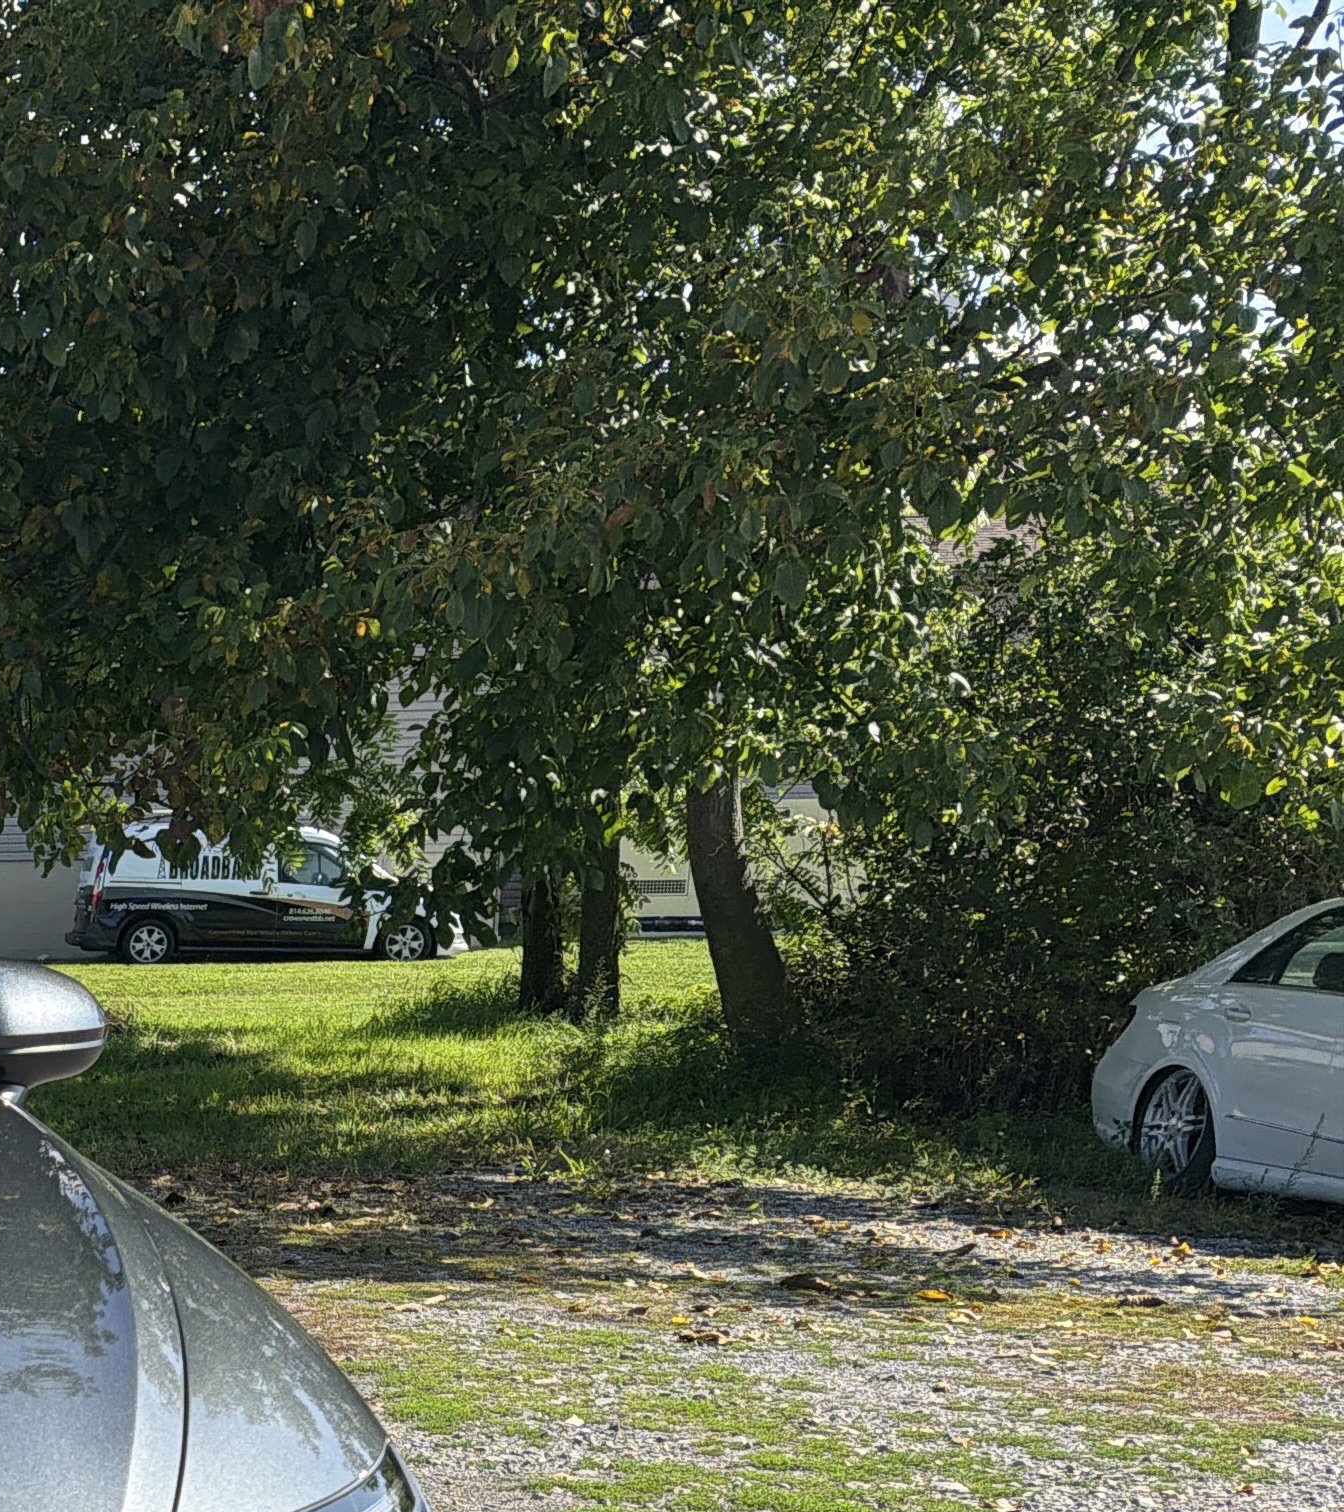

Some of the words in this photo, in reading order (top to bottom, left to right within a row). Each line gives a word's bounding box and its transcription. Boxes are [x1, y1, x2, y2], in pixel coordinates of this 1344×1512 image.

[109, 902, 128, 911] High
[128, 902, 150, 911] Speed
[150, 902, 179, 911] Wireless
[179, 903, 209, 911] Internet
